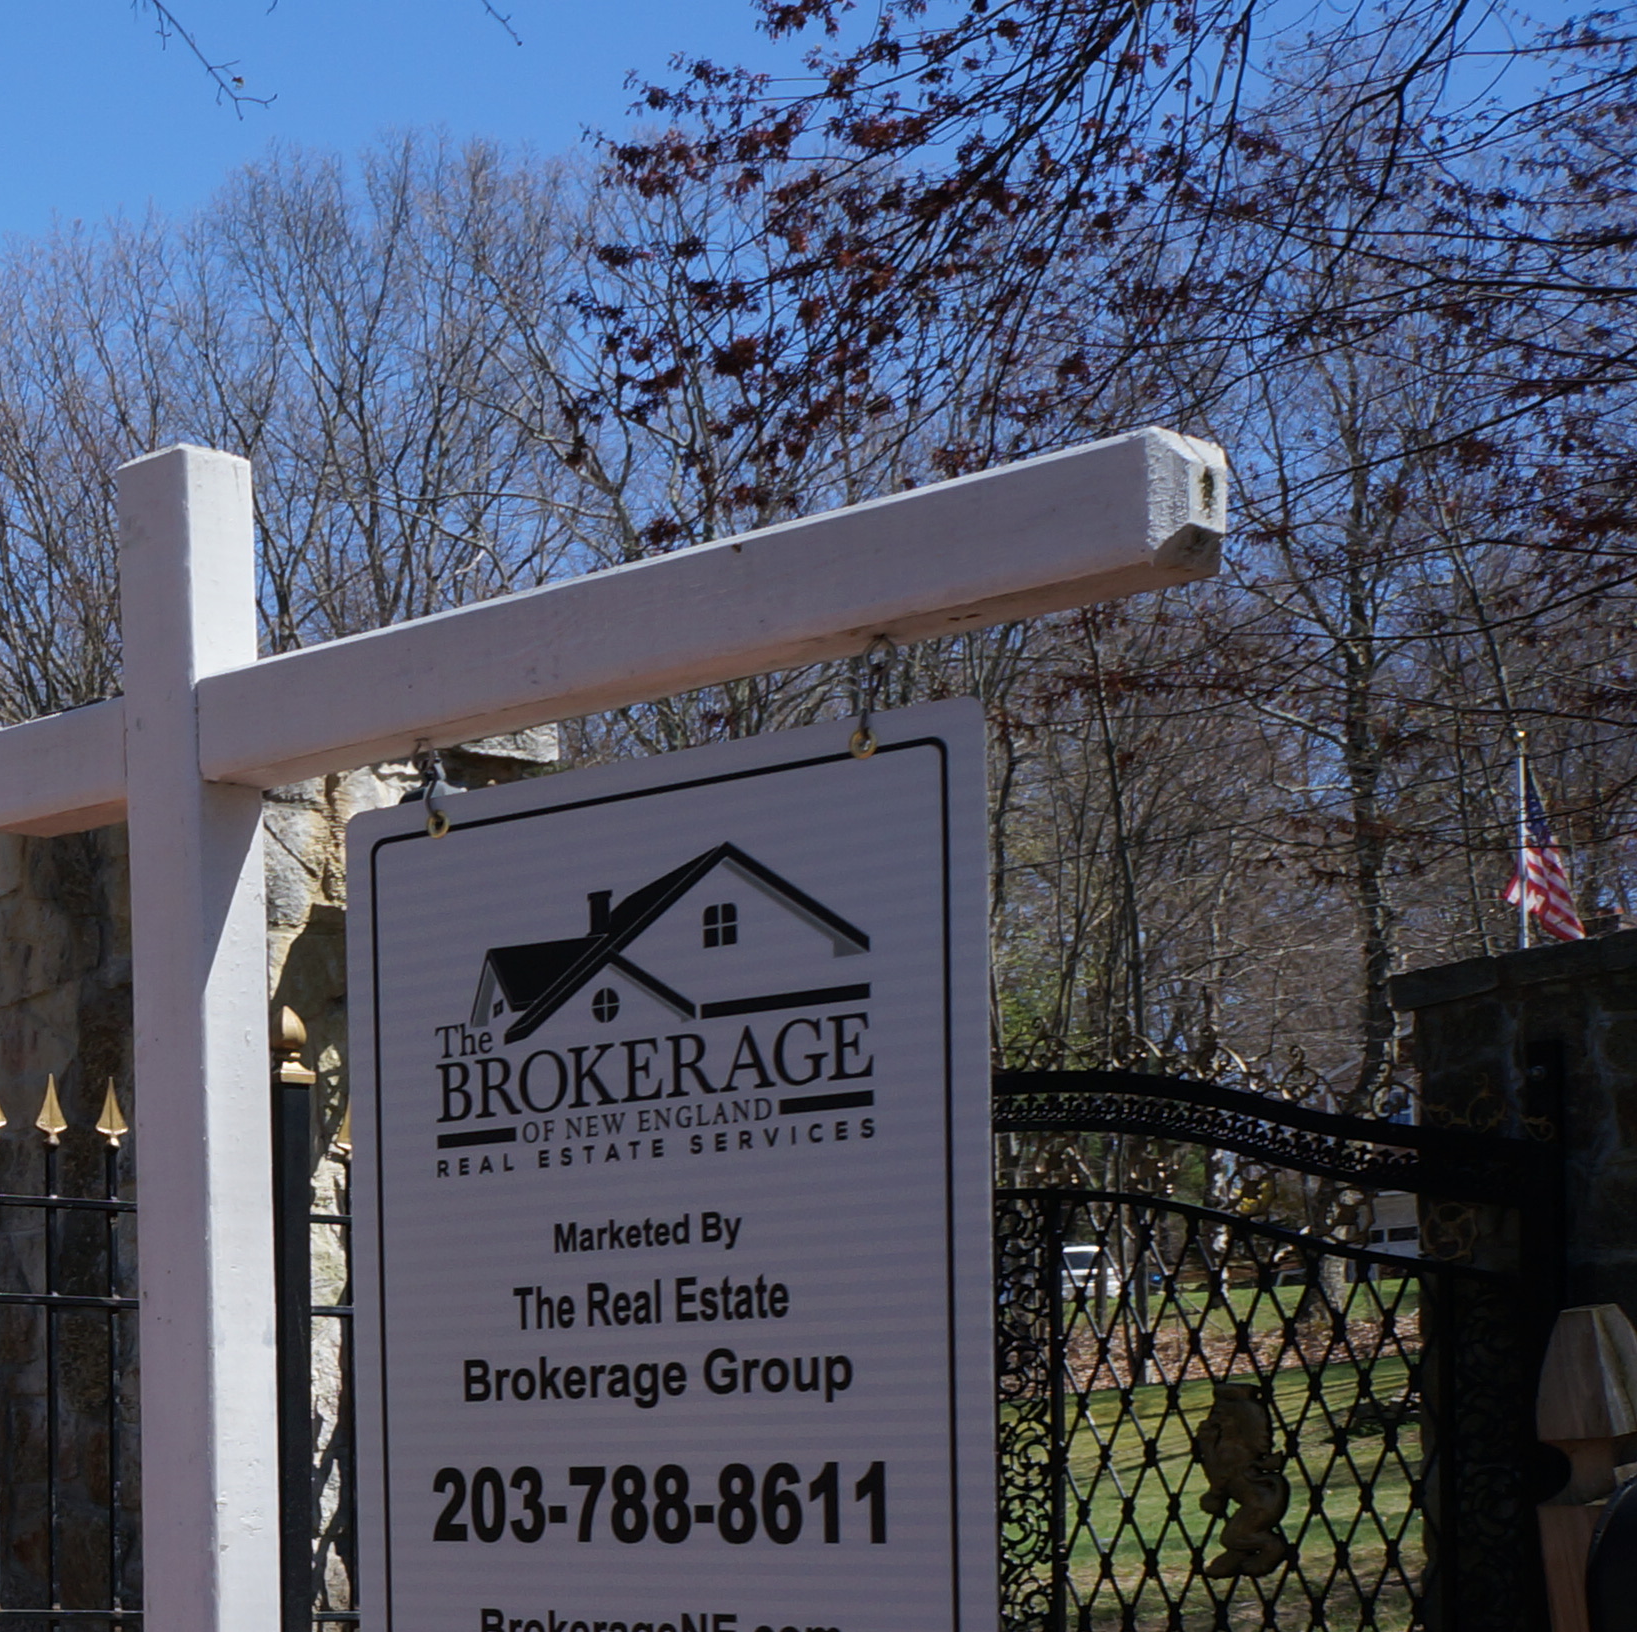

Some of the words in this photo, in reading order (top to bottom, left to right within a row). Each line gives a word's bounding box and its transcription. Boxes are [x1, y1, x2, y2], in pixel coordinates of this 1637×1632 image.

[435, 1023, 493, 1060] The
[435, 1012, 875, 1123] BROKERAGE
[436, 1152, 515, 1178] REAL
[537, 1137, 665, 1169] ESTATE
[689, 1117, 876, 1155] SERVICES
[522, 1119, 555, 1144] OF
[565, 1111, 626, 1140] NEW
[637, 1097, 773, 1133] ENGLAND
[553, 1213, 690, 1254] Marketed
[700, 1211, 743, 1250] By
[513, 1286, 576, 1331] The
[587, 1279, 663, 1328] Real
[674, 1274, 790, 1322] Estate
[463, 1356, 687, 1409] Brokerage
[702, 1347, 853, 1404] Group
[432, 1460, 888, 1545] 203-788-8611
